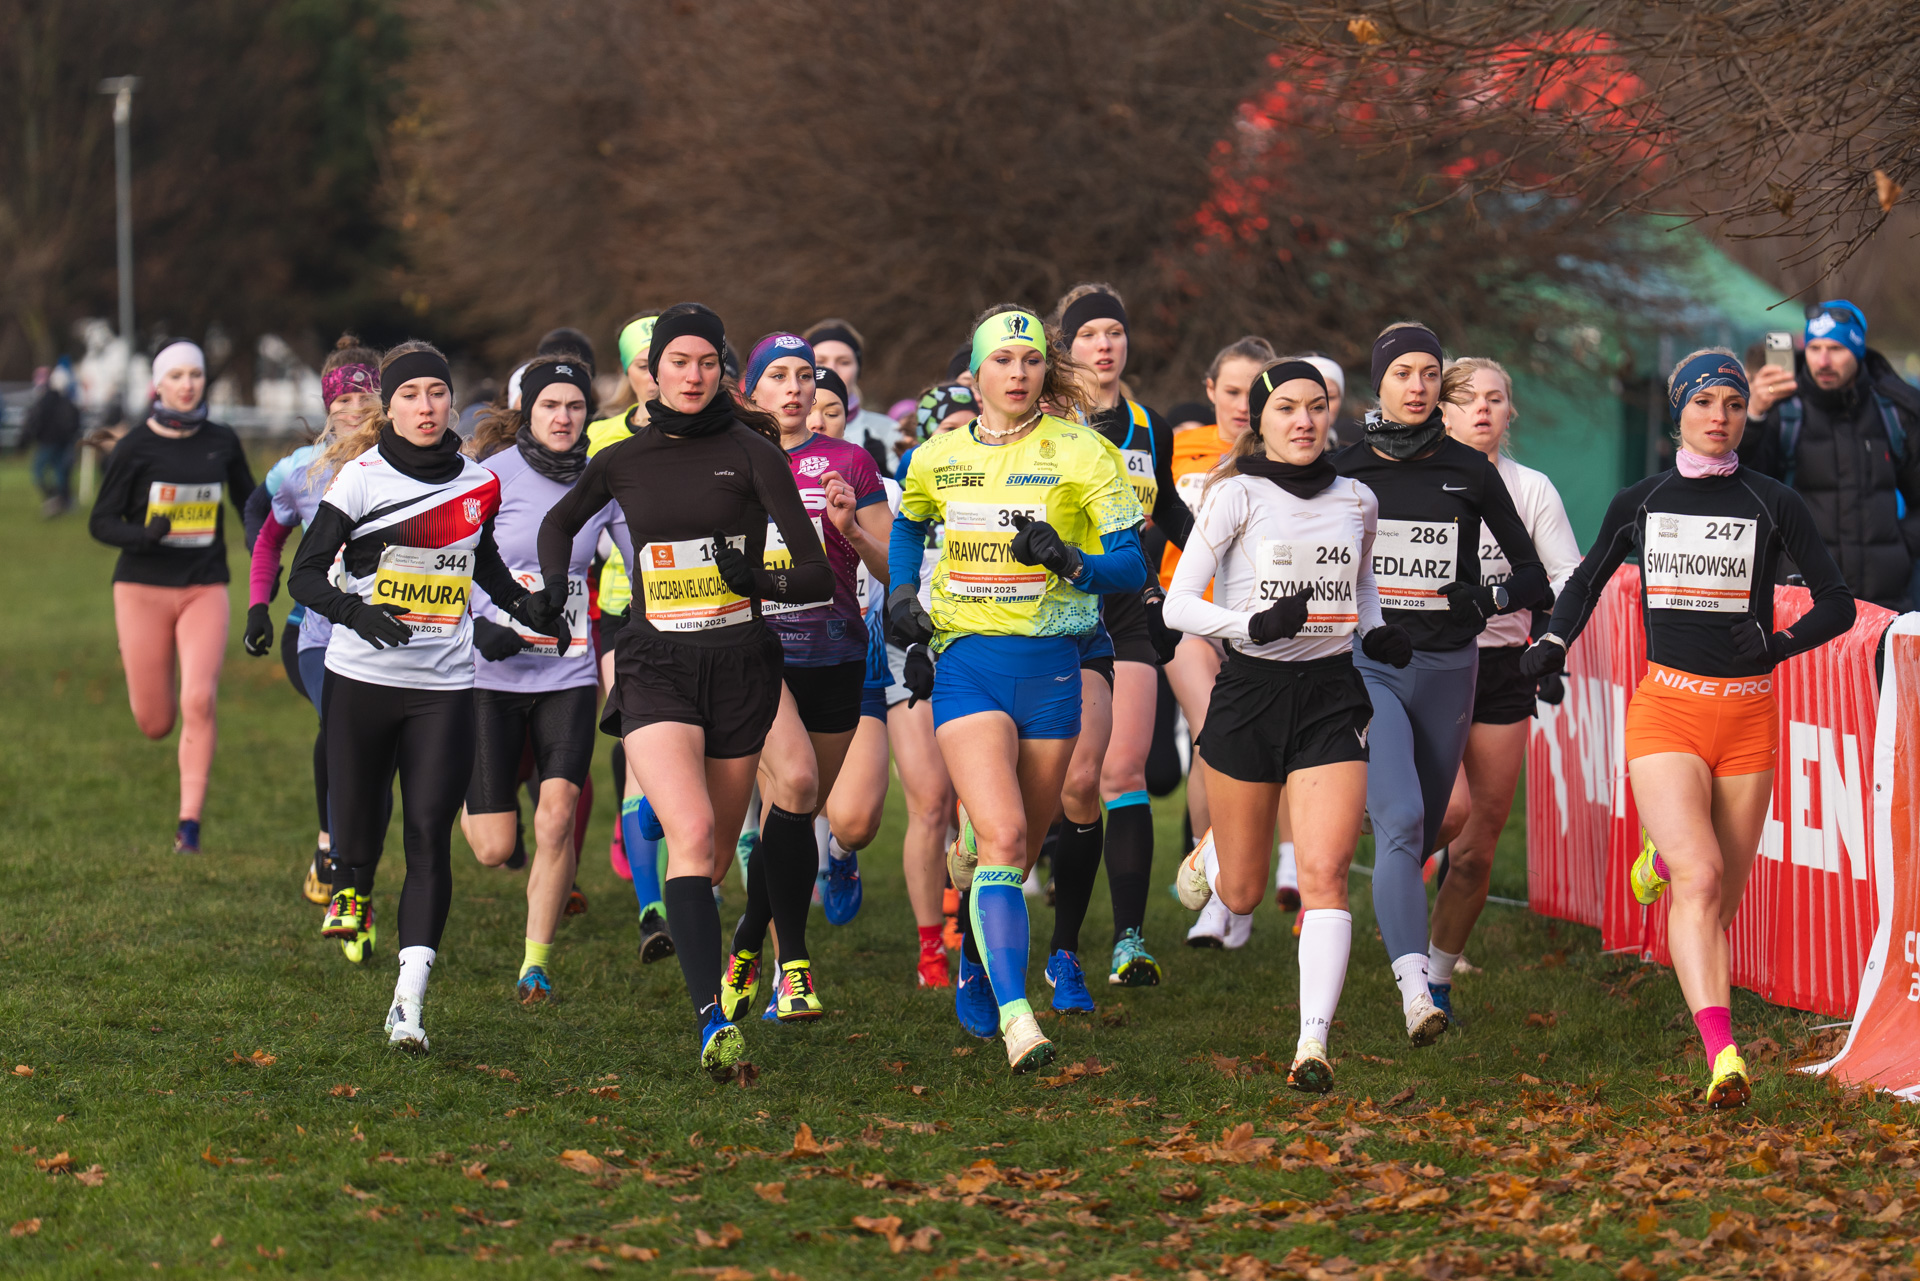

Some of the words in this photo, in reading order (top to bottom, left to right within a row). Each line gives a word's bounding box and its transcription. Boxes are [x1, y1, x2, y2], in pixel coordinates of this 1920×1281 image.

[933, 465, 972, 473] GRUSZFELD
[1410, 527, 1448, 545] 286
[1705, 522, 1746, 541] 247
[1316, 546, 1351, 565] 246
[1481, 545, 1504, 560] 22
[434, 554, 467, 571] 344
[1373, 556, 1451, 579] EDLARZ
[1647, 548, 1747, 578] ŚWIĄTKOWSKA
[377, 579, 466, 606] CHMURA
[648, 579, 684, 601] KUCZABA
[683, 578, 698, 599] VEL
[966, 586, 992, 594] LUBIN
[993, 586, 1017, 594] 2025
[1380, 597, 1401, 606] UBIN
[1403, 599, 1426, 607] 2025
[1665, 598, 1693, 607] LUBIN
[1695, 600, 1719, 609] 2025
[421, 625, 442, 634] 2025
[675, 621, 703, 629] LUBIN
[704, 617, 726, 627] 2025
[1313, 625, 1333, 633] 2025
[777, 632, 811, 640] LWOZ
[1654, 669, 1720, 696] NIKE
[1723, 679, 1771, 697] PRO
